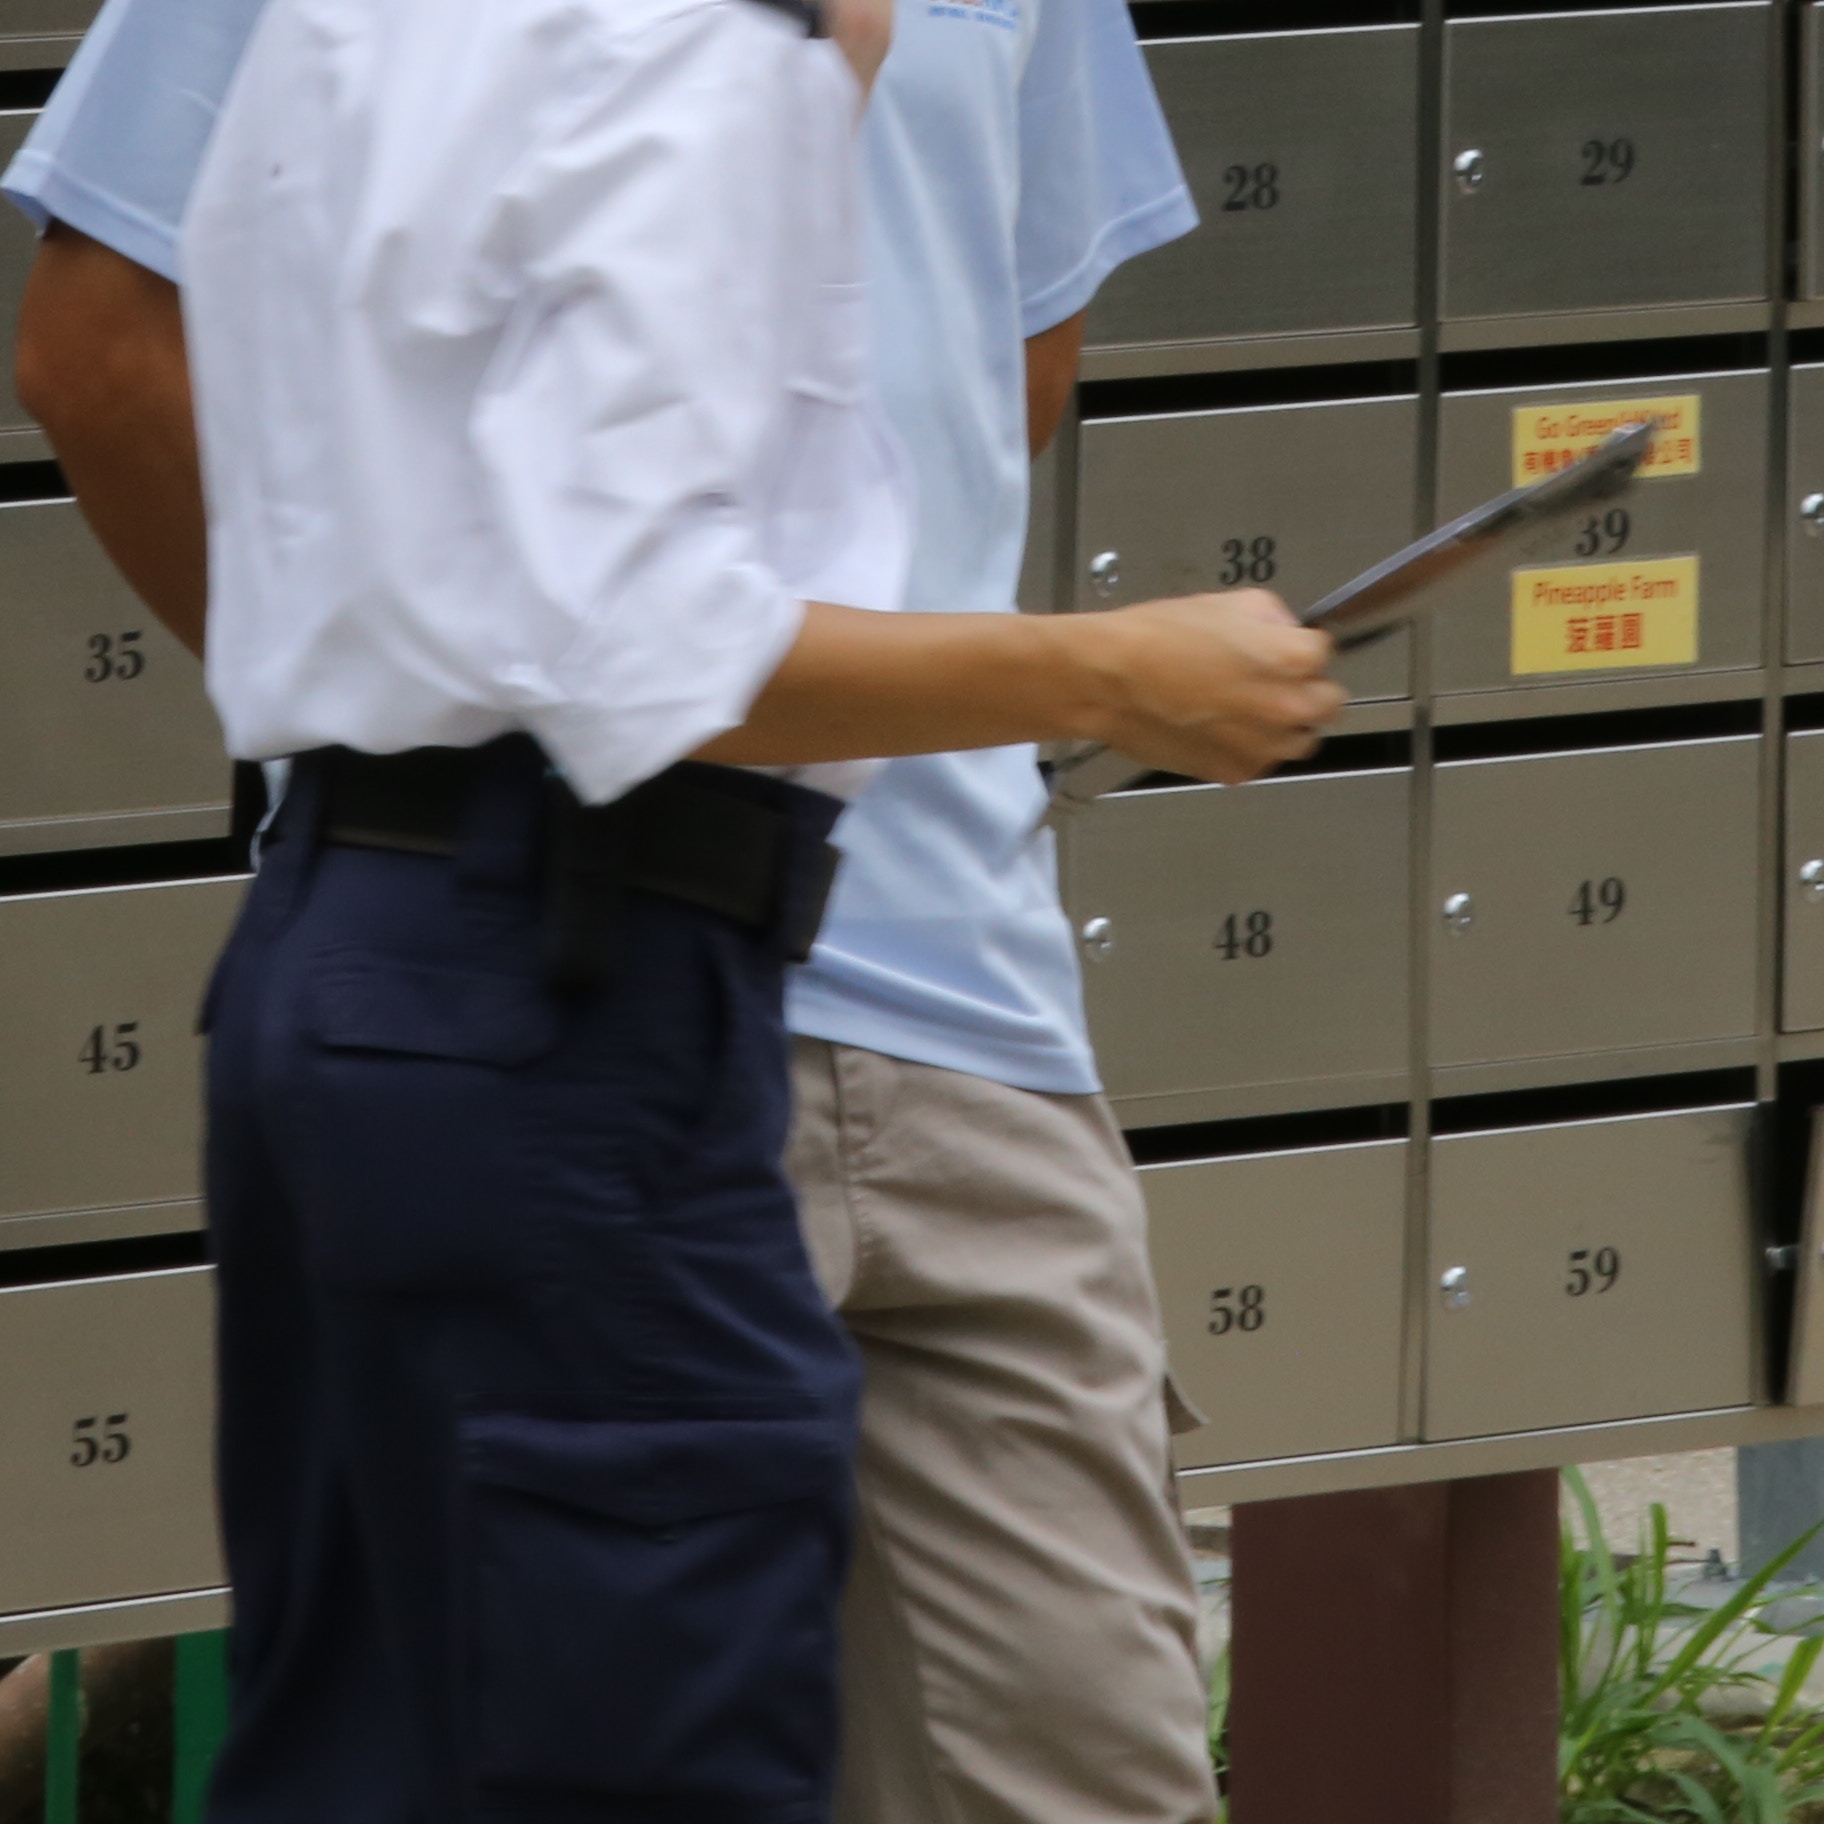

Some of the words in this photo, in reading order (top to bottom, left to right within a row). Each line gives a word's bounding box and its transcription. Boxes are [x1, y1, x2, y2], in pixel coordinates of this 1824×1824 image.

[1580, 138, 1635, 186] 29
[1221, 163, 1280, 212] 28
[1536, 416, 1560, 440] Go
[1576, 507, 1632, 557] 39
[1219, 536, 1276, 586] 38
[1532, 577, 1626, 609] Pineapple
[1631, 574, 1680, 601] Farm
[85, 631, 145, 683] 35
[1569, 877, 1626, 926] 49
[1215, 910, 1273, 960] 48
[80, 1022, 141, 1074] 45
[1566, 1247, 1620, 1297] 59
[1208, 1285, 1265, 1335] 58
[70, 1413, 131, 1467] 55
